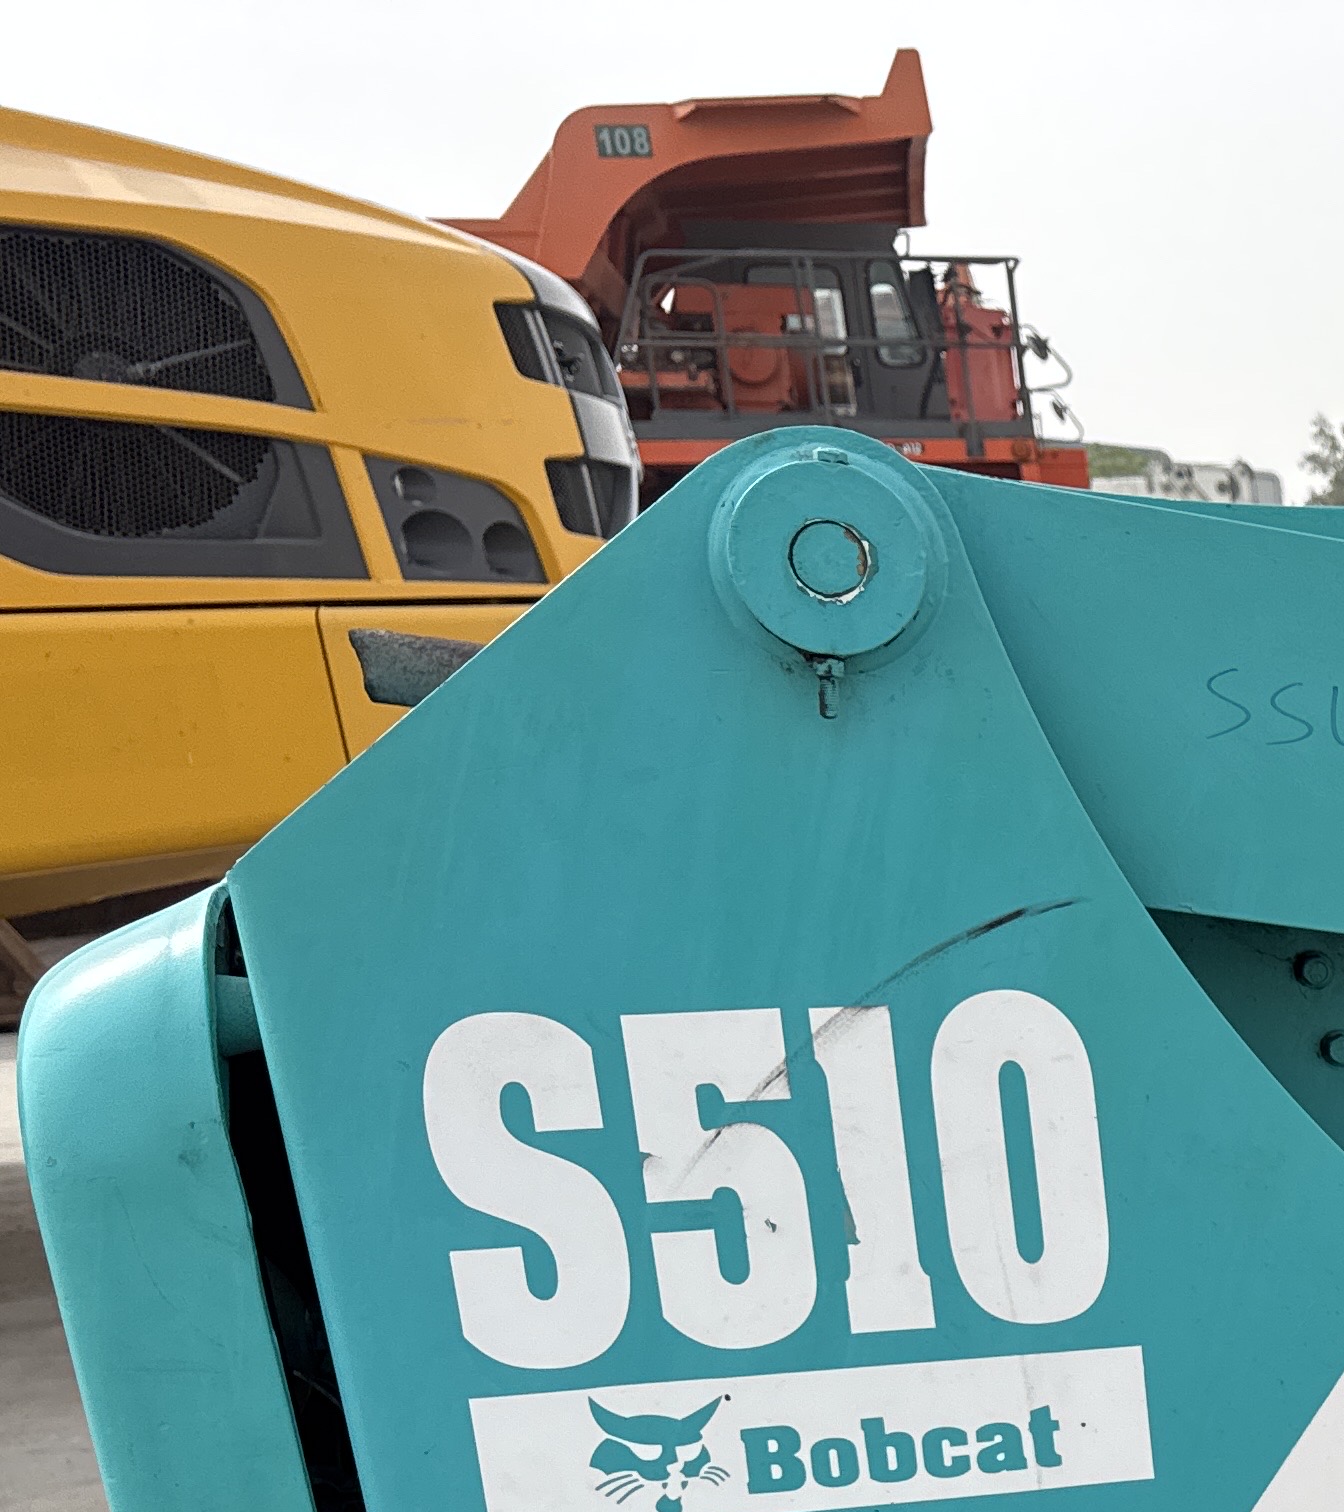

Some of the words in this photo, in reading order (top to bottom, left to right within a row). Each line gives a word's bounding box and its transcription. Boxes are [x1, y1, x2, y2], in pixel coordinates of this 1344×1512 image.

[599, 127, 650, 155] 108
[422, 988, 1111, 1370] S510
[740, 1404, 1063, 1496] Bobcat
